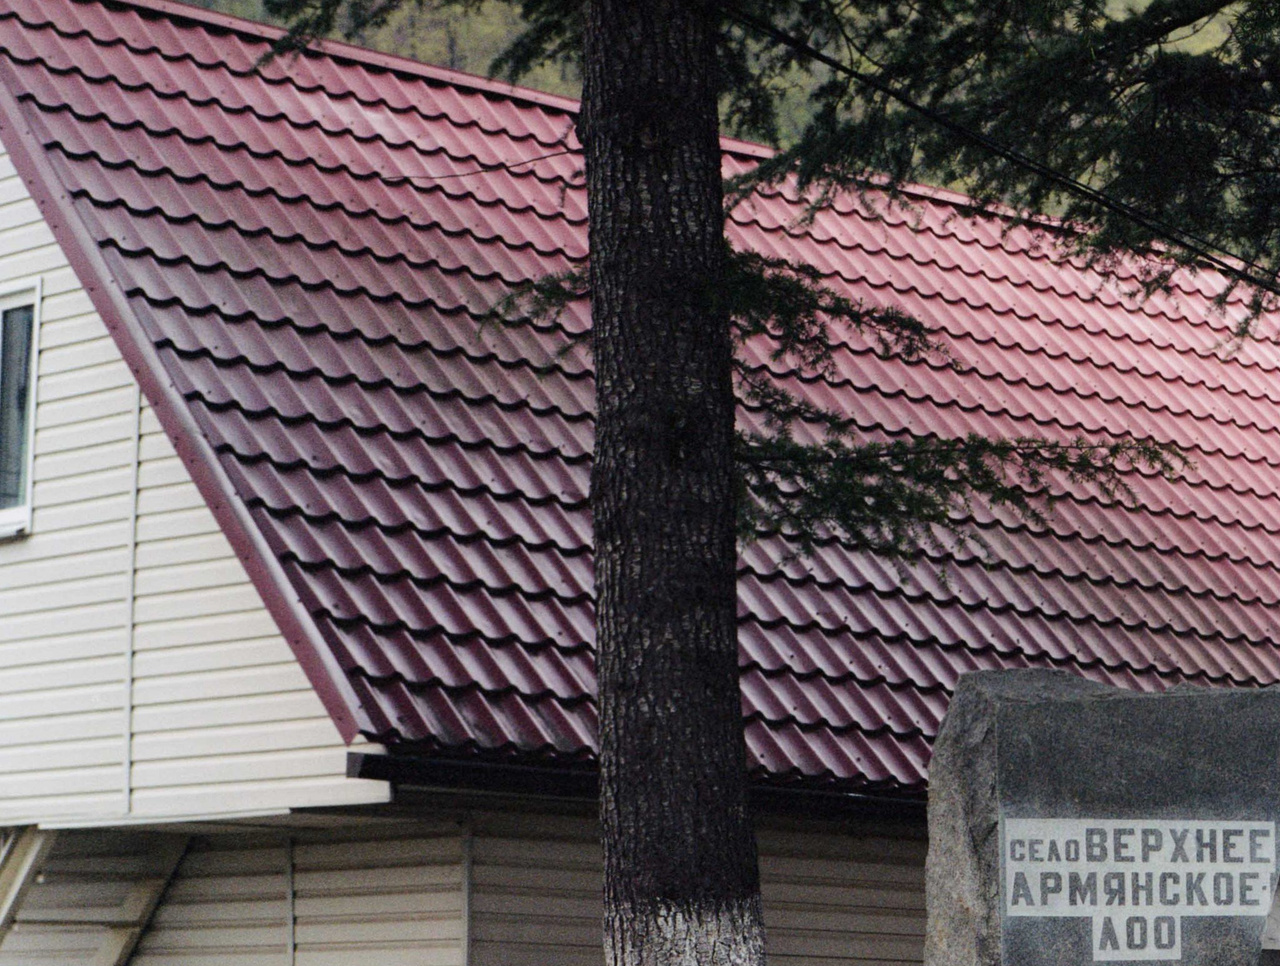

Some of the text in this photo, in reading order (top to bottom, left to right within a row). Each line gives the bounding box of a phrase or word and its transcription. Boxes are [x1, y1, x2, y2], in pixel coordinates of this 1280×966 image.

[1009, 827, 1271, 864] СЕЛО ВЕРХНЕЕ
[1010, 871, 1260, 907] АРМЯНСКОЕ
[1098, 916, 1176, 951] ЛОО
